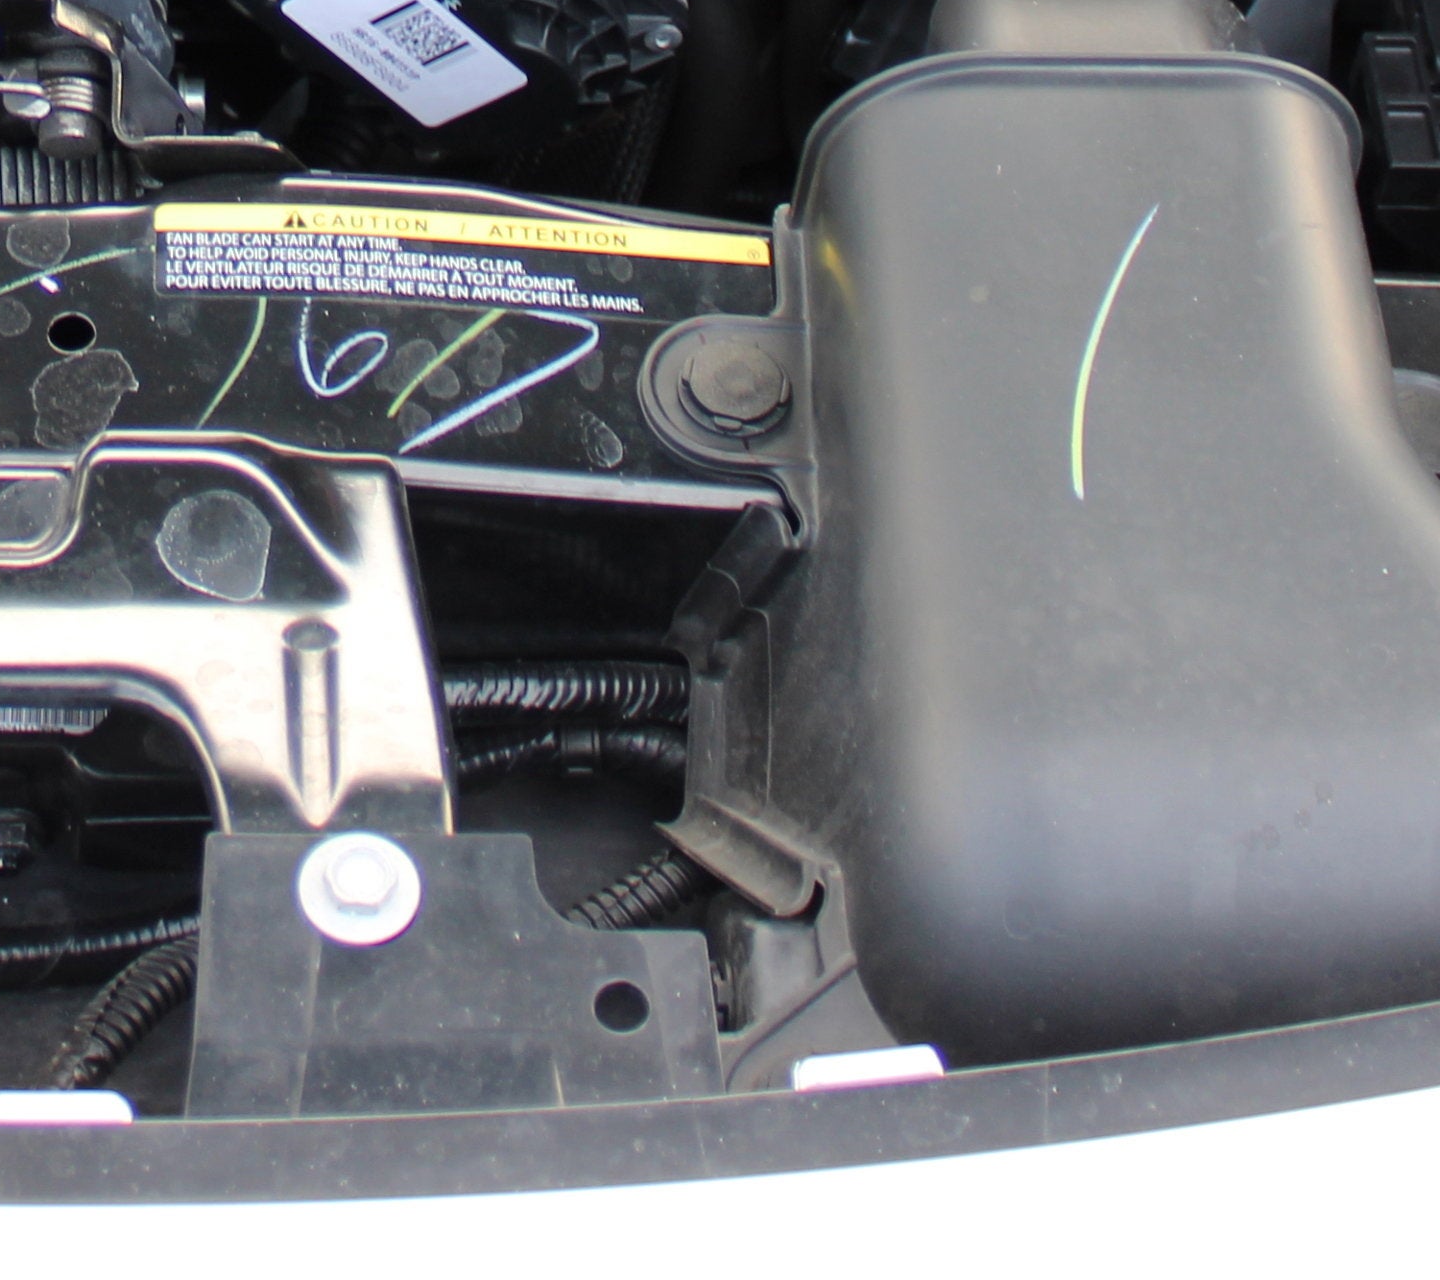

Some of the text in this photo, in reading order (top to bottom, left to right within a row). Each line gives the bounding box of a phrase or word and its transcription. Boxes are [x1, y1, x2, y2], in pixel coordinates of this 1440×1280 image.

[167, 232, 403, 251] FAN BLADE CAN START AT ANY TIME.
[313, 215, 429, 233] CAUTION
[489, 224, 629, 248] ATTENTION
[167, 260, 182, 274] LE
[186, 260, 283, 276] VENTILATEUR
[288, 262, 341, 279] RISQUE
[345, 264, 365, 278] DE
[466, 272, 506, 287] TOUT
[509, 275, 578, 293] MOMENT.
[168, 247, 526, 275] TO HELP AVOID PERSONAL INJURY, KEEP HANDS CLEAR.
[166, 275, 208, 289] POUR
[265, 276, 313, 291] TOUTE
[316, 278, 393, 297] BLESSURE,
[395, 282, 415, 296] NE
[419, 283, 446, 298] PAS
[449, 285, 469, 299] EN
[472, 287, 562, 306] APPROCHER
[564, 293, 590, 309] LES
[592, 295, 645, 313] MAINS.
